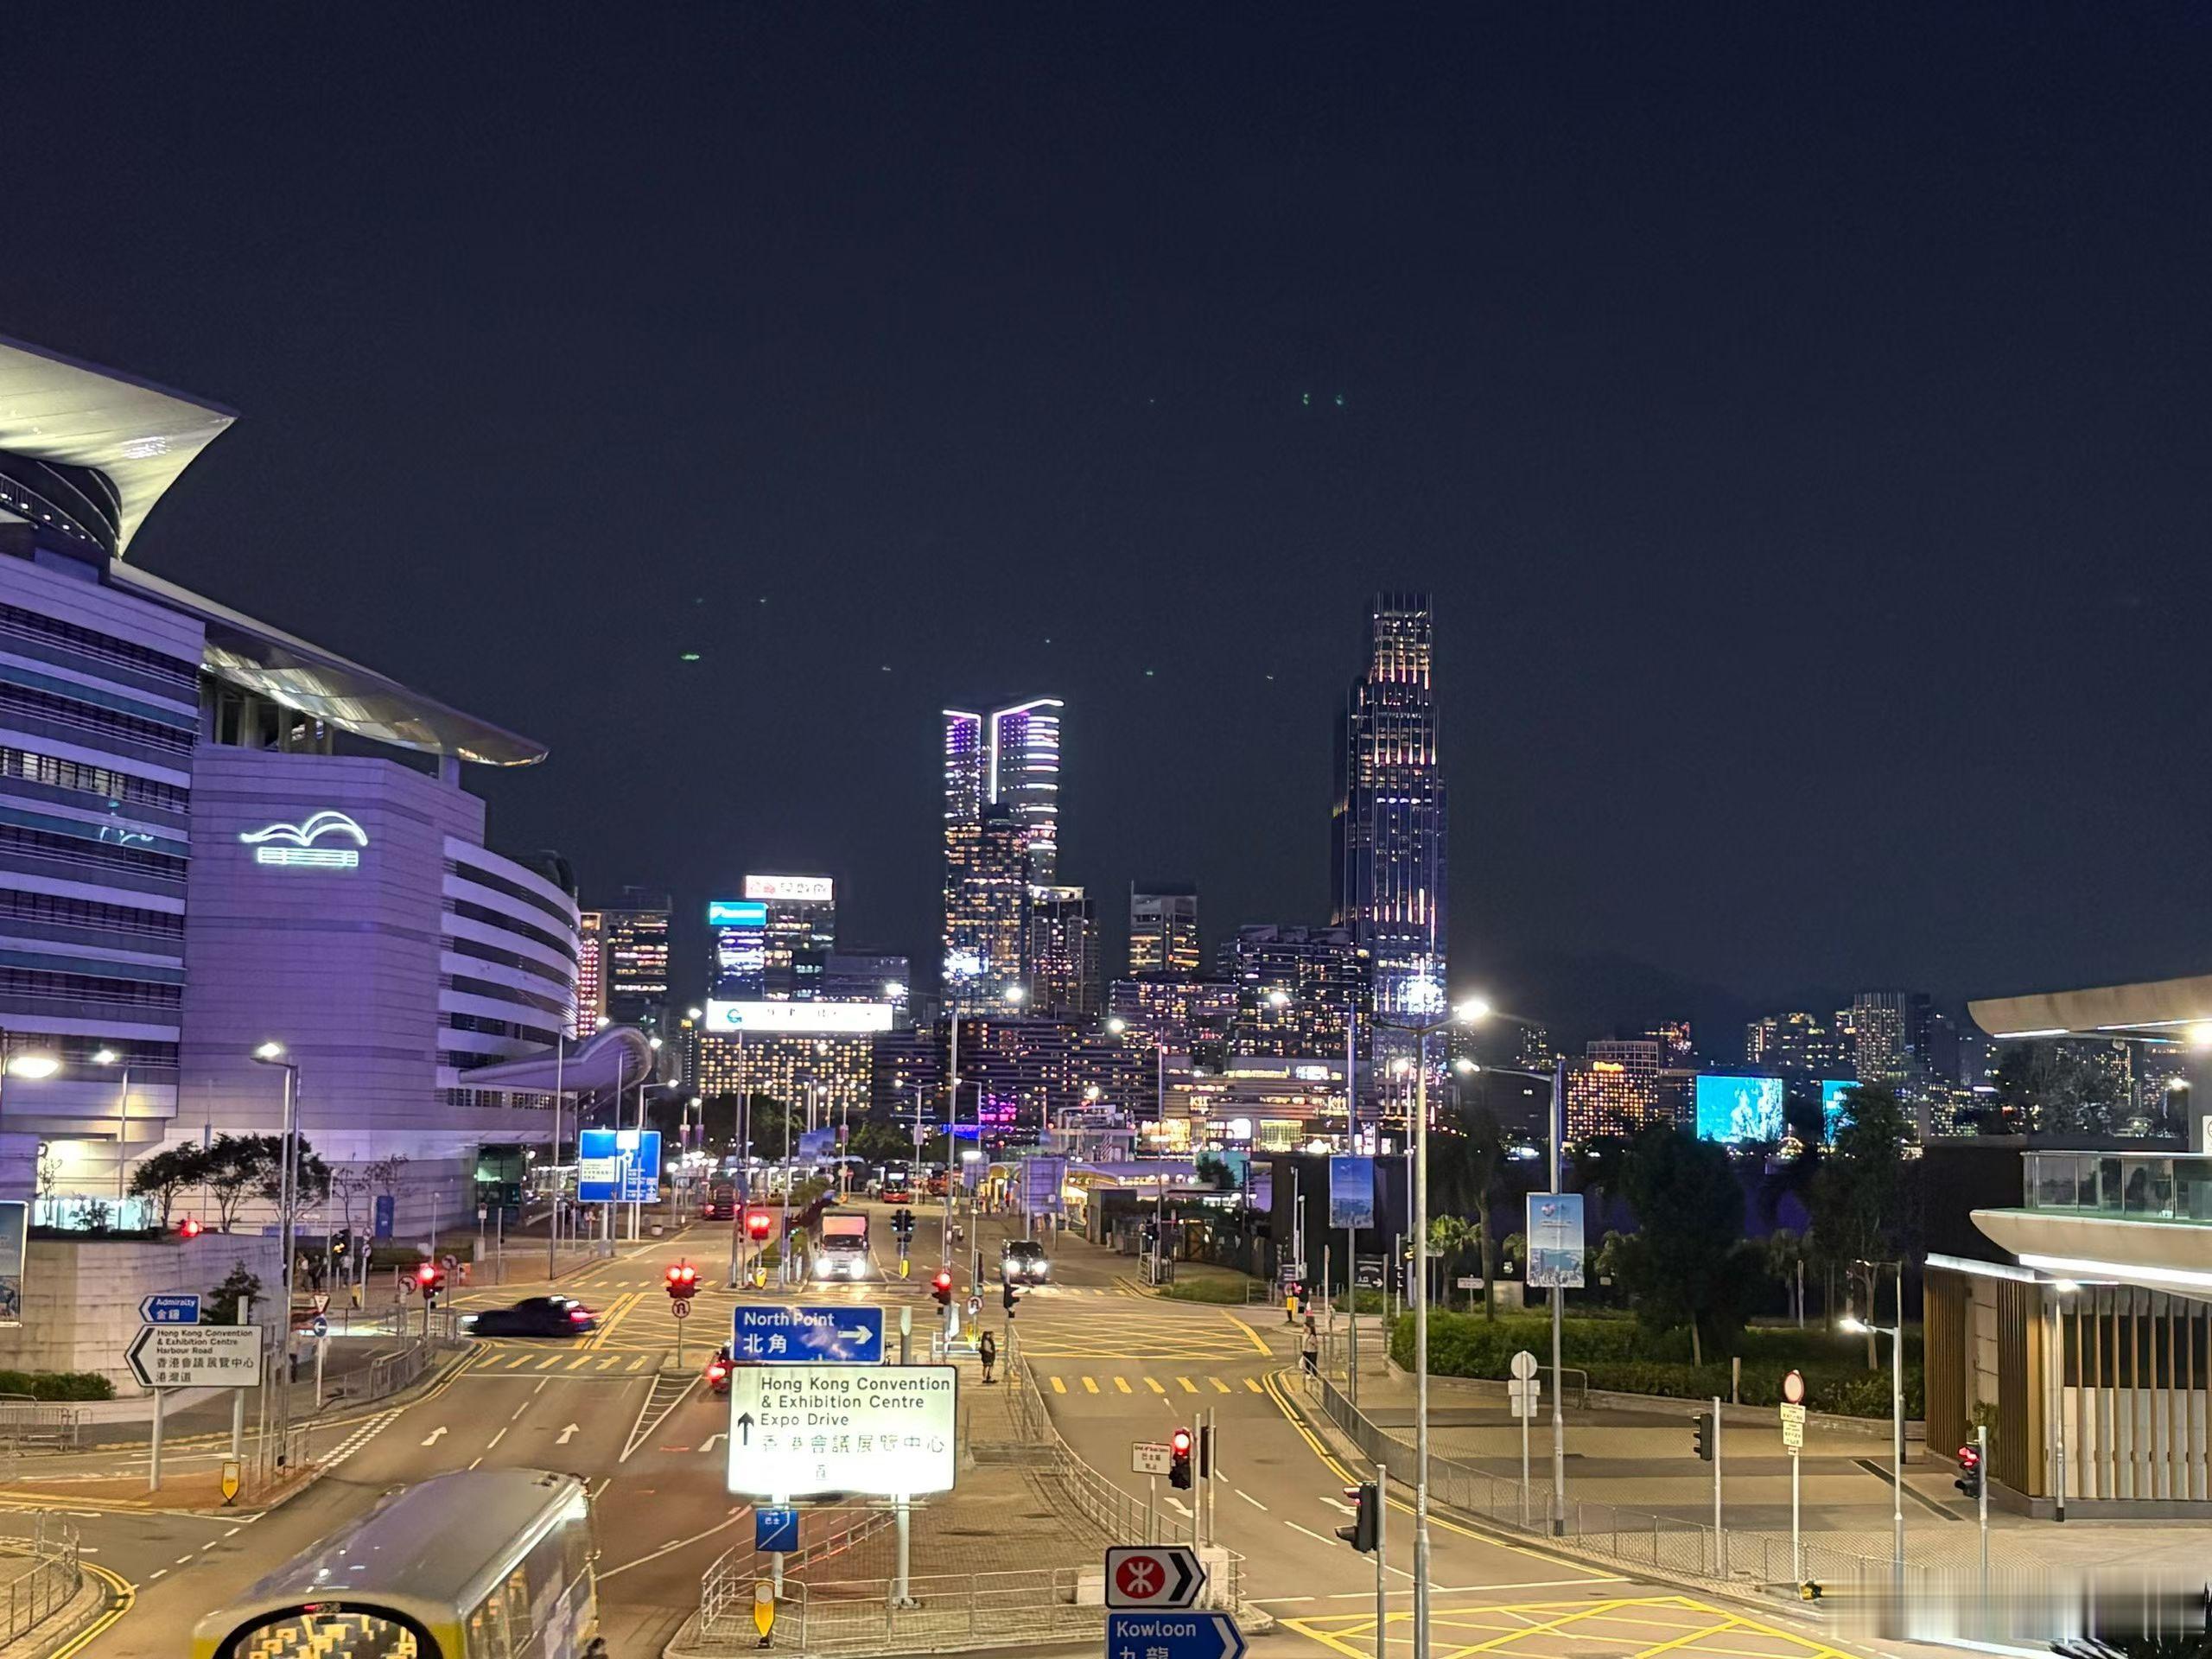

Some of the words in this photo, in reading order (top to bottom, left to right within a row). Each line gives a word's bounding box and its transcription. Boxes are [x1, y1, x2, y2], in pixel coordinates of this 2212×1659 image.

[156, 1299, 195, 1307] Admiralty
[744, 1312, 790, 1326] North
[792, 1312, 835, 1326] Point
[156, 1329, 180, 1338] Hong
[181, 1329, 203, 1338] Kong
[205, 1329, 253, 1338] Convention
[743, 1333, 787, 1354] 北角
[156, 1357, 254, 1369] 香港會議展覽中心
[761, 1377, 803, 1393] Hong
[810, 1377, 849, 1393] Kong
[857, 1376, 950, 1391] Convention
[761, 1395, 772, 1408] &
[779, 1395, 861, 1408] Exhibition
[869, 1395, 925, 1408] Centre
[760, 1414, 799, 1427] Expo
[808, 1413, 849, 1426] Drive
[1116, 1621, 1197, 1637] Kowloon
